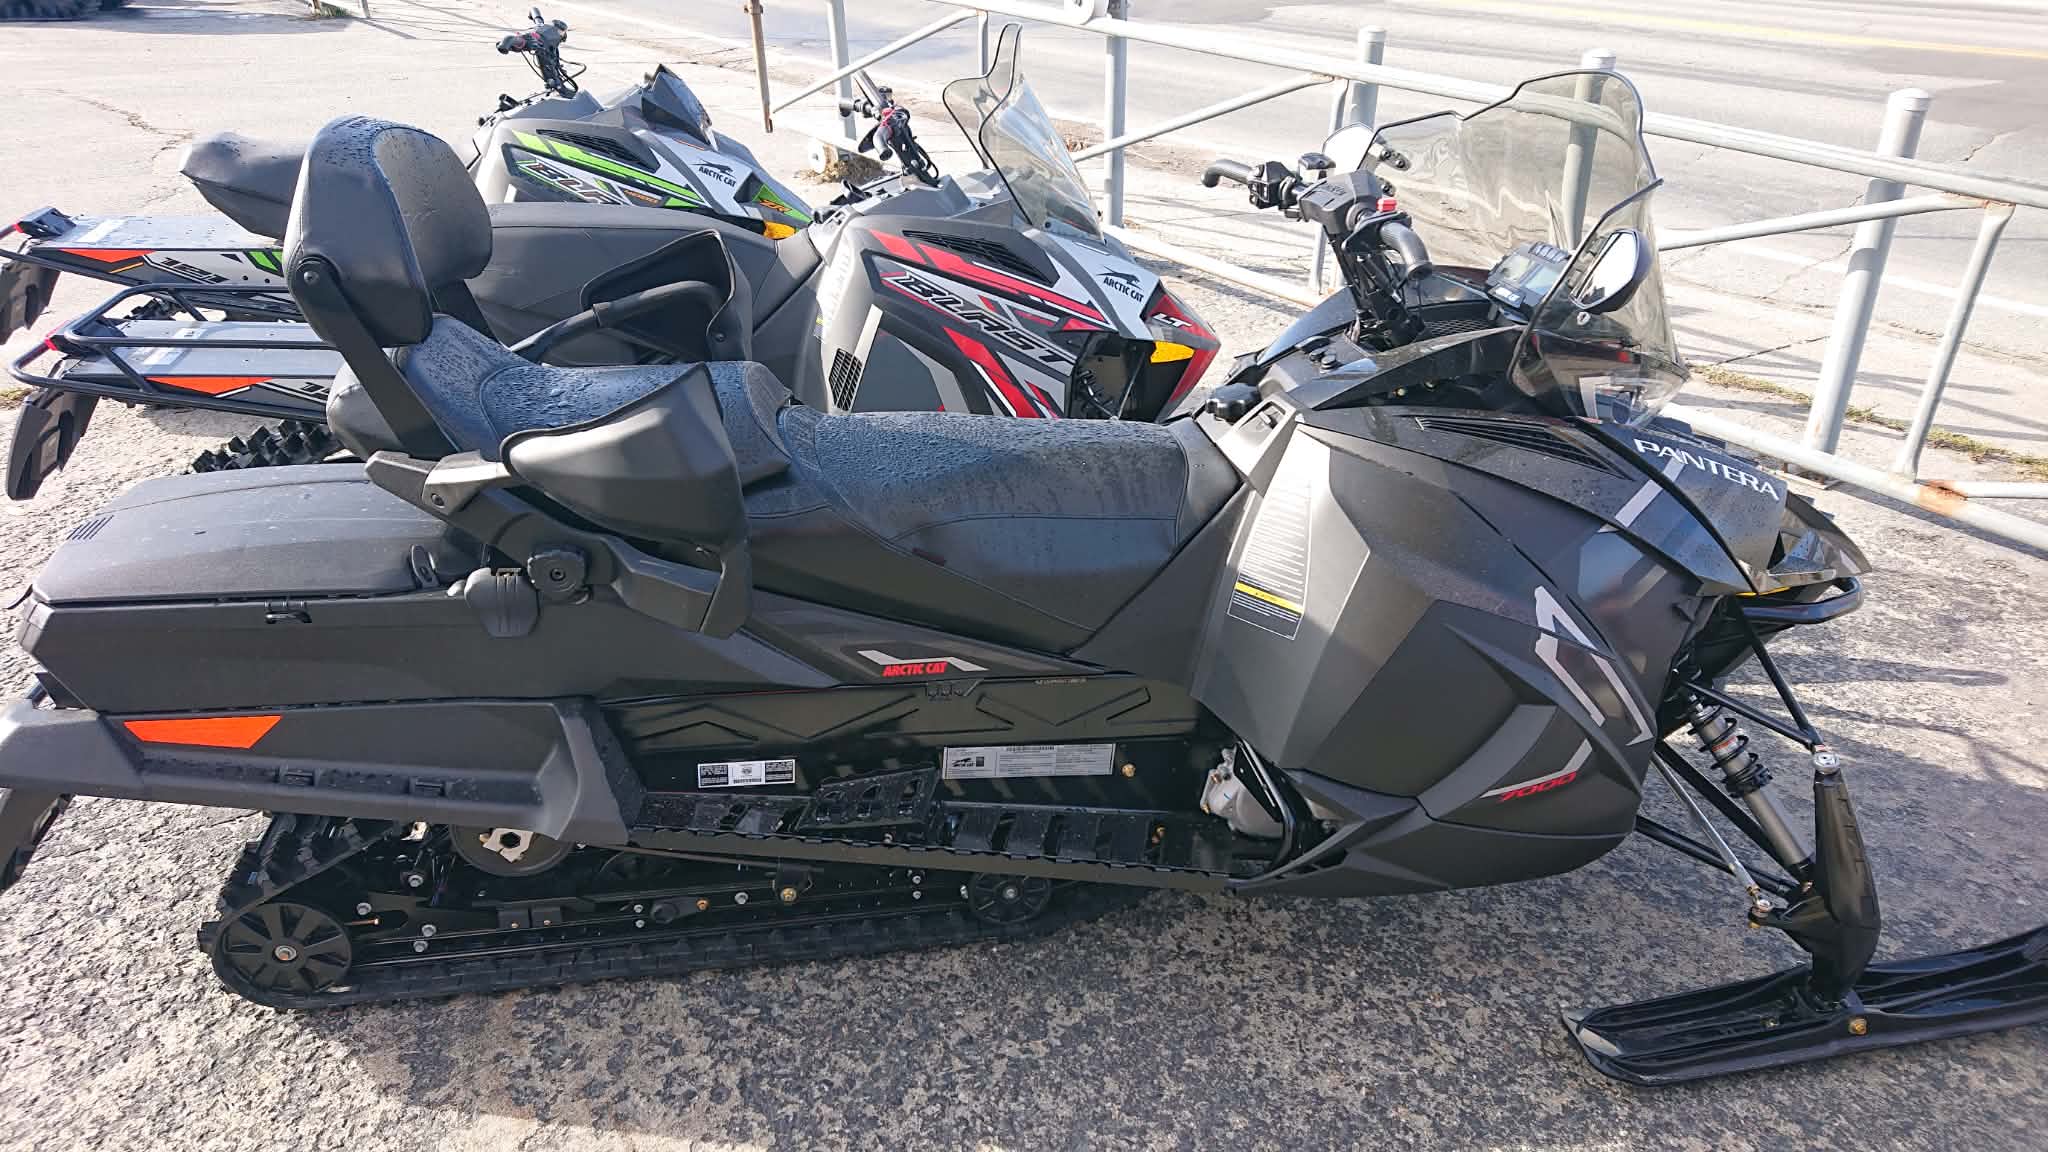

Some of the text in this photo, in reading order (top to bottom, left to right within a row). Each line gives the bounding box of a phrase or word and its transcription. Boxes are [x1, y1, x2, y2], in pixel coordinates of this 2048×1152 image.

[698, 166, 737, 188] ARCTIC CAT
[1103, 276, 1145, 302] ARCTIC CAT
[884, 272, 1076, 367] BLAST
[1152, 312, 1192, 328] LT
[1634, 438, 1780, 500] PANTERA
[882, 661, 948, 677] ARCTIC CAT
[1498, 771, 1577, 802] 7000
